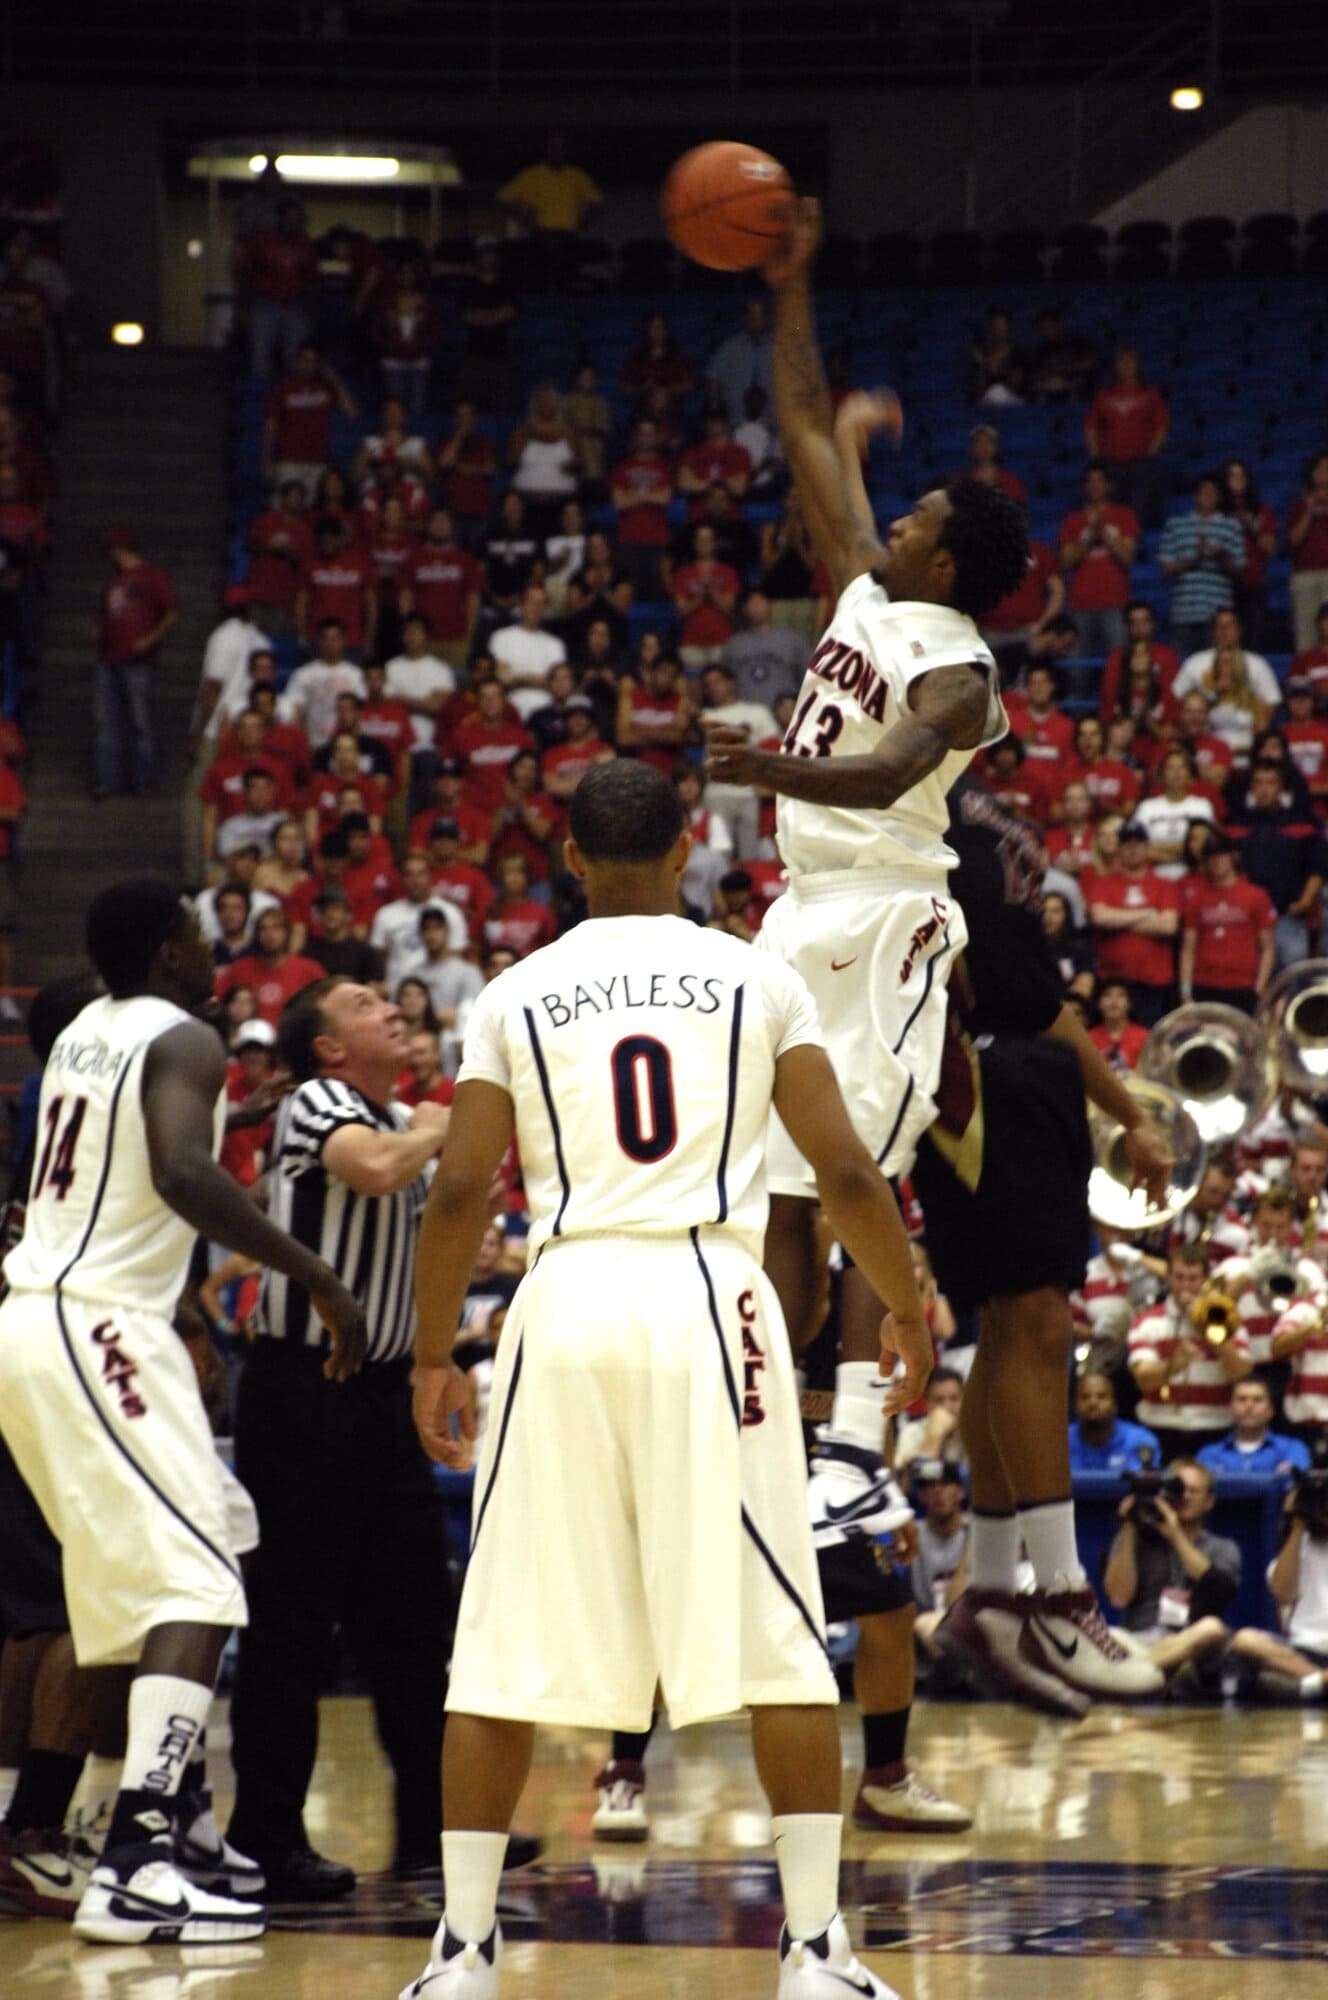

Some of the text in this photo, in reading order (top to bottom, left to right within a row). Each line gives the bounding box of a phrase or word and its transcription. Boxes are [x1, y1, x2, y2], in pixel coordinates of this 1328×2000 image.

[541, 974, 724, 1028] BAYLESS
[32, 1094, 88, 1201] 14
[611, 1034, 679, 1165] 0
[91, 1318, 147, 1419] CATS
[737, 1290, 765, 1427] CATS
